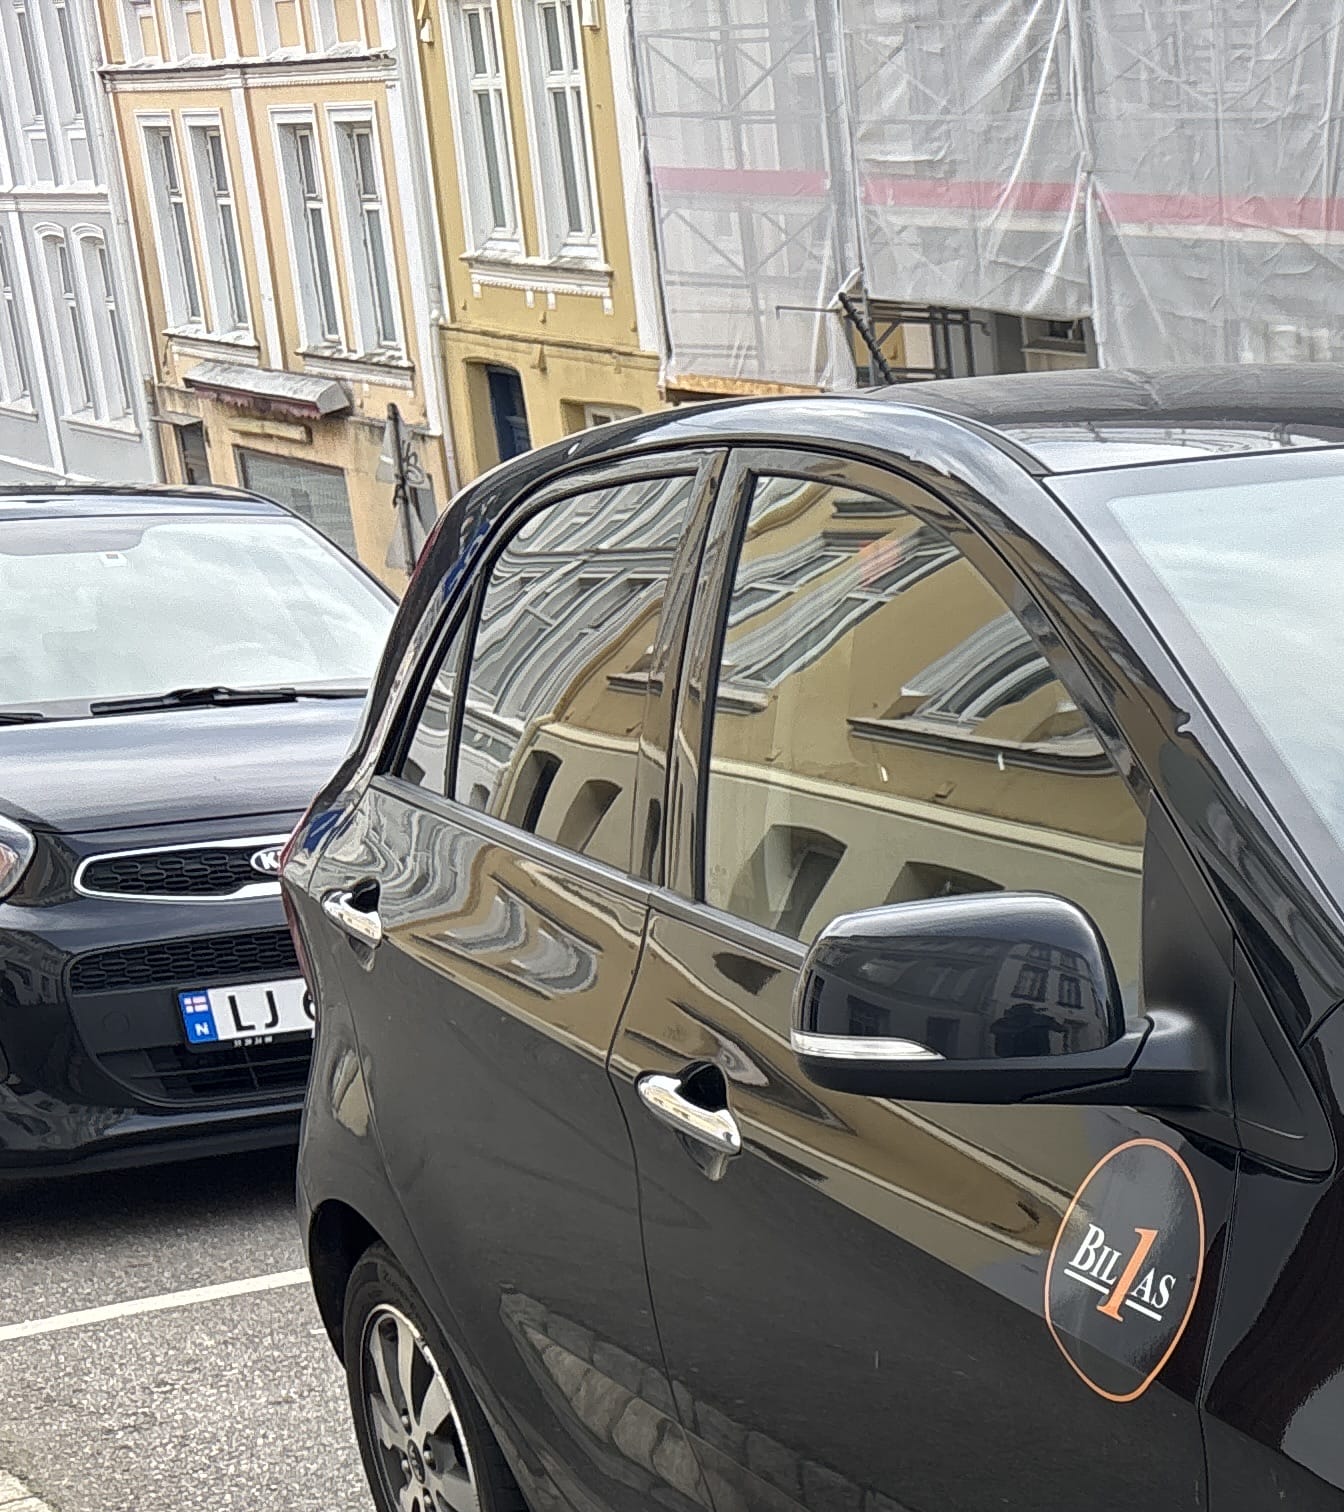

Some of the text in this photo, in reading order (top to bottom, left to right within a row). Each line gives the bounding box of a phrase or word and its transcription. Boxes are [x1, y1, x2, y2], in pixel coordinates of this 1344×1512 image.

[194, 1022, 210, 1036] N
[227, 990, 279, 1032] LJ
[1130, 1266, 1177, 1310] AS
